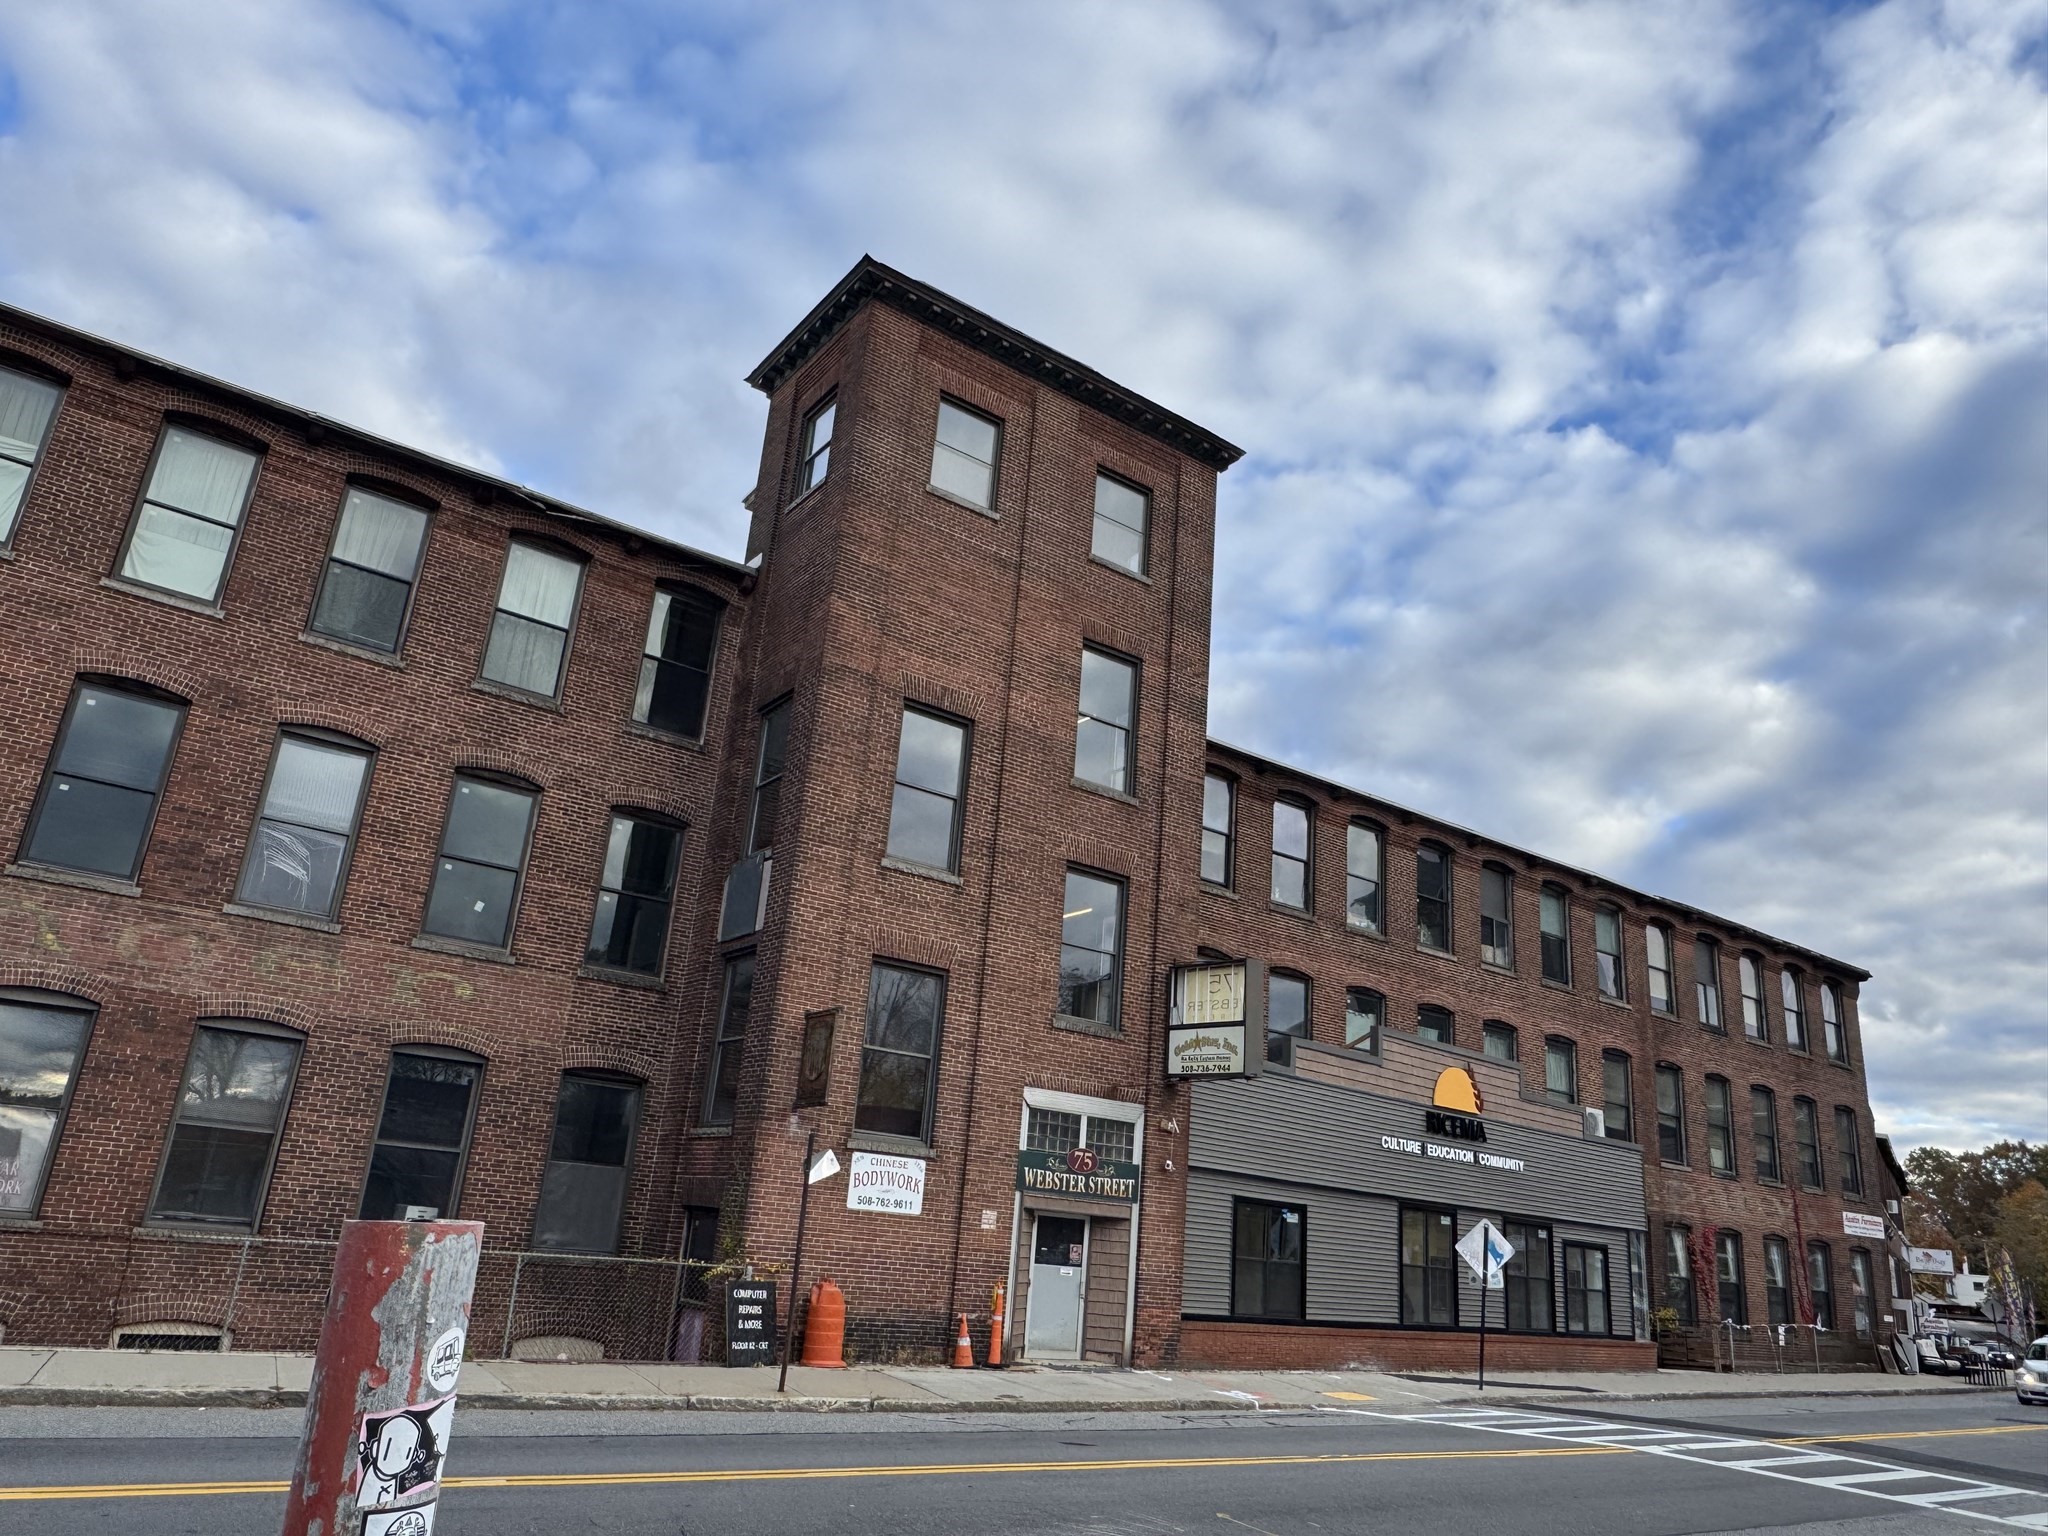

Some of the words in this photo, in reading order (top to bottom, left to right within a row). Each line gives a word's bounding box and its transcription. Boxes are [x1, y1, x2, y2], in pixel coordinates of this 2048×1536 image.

[1074, 1151, 1093, 1171] 75
[1381, 1135, 1422, 1154] CULTURE
[1427, 1144, 1474, 1164] EDUCATION
[1478, 1153, 1525, 1172] COMMUNITY
[870, 1157, 909, 1170] CHINESE
[853, 1170, 922, 1195] BODYWORK
[1023, 1166, 1086, 1193] WEBSTER
[1088, 1176, 1135, 1198] STREET
[857, 1195, 913, 1210] 508-762-9611
[733, 1288, 768, 1299] COMPUTER
[738, 1304, 763, 1315] REPAIRS
[738, 1319, 744, 1329] &
[744, 1320, 763, 1330] MORE
